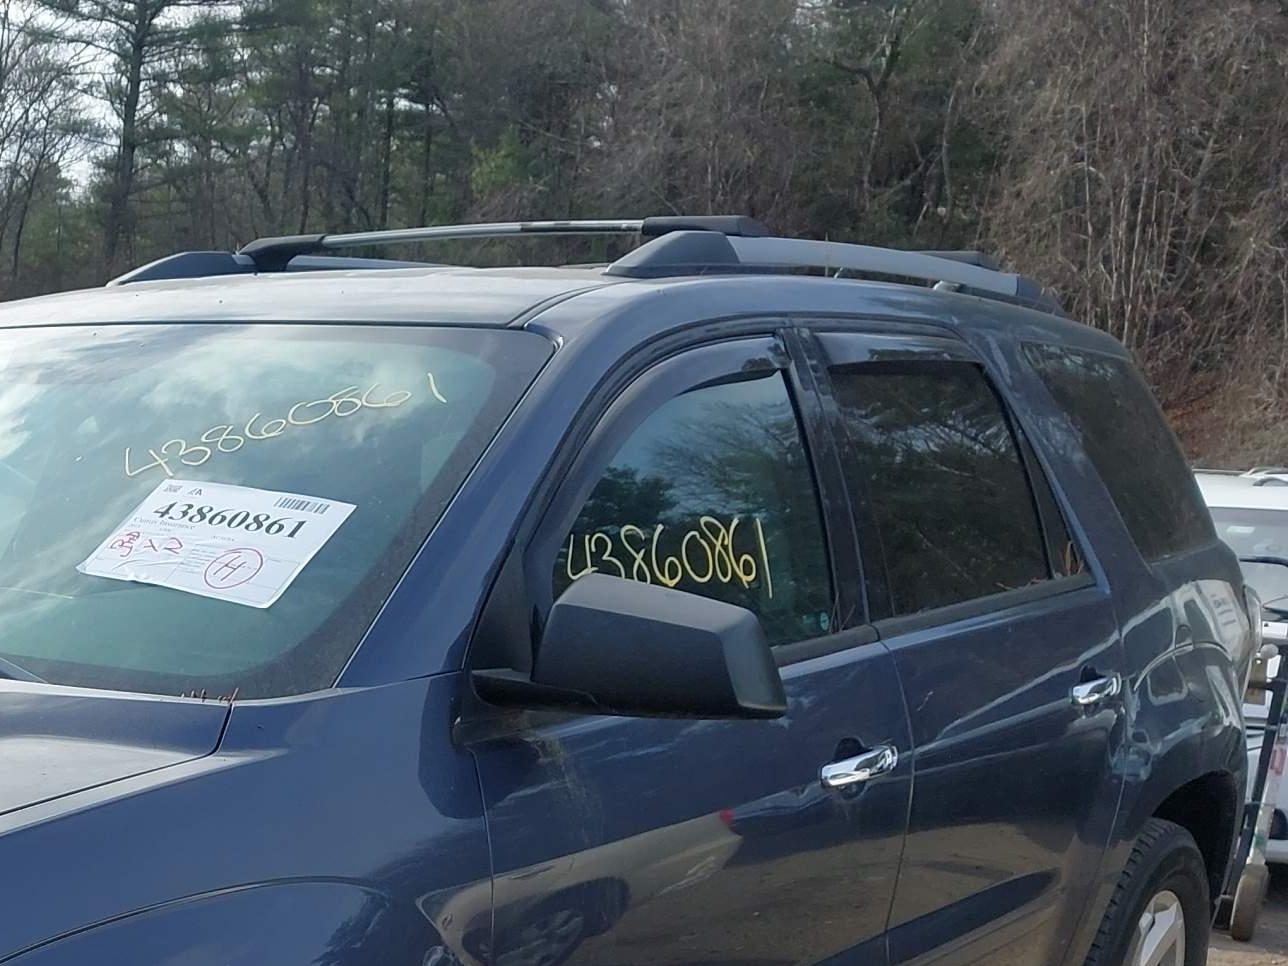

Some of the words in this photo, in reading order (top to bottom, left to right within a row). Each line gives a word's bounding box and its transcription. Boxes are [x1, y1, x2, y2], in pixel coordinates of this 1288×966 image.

[125, 373, 447, 479] 43860861
[153, 501, 307, 539] 43860861
[566, 516, 774, 600] 43860861
